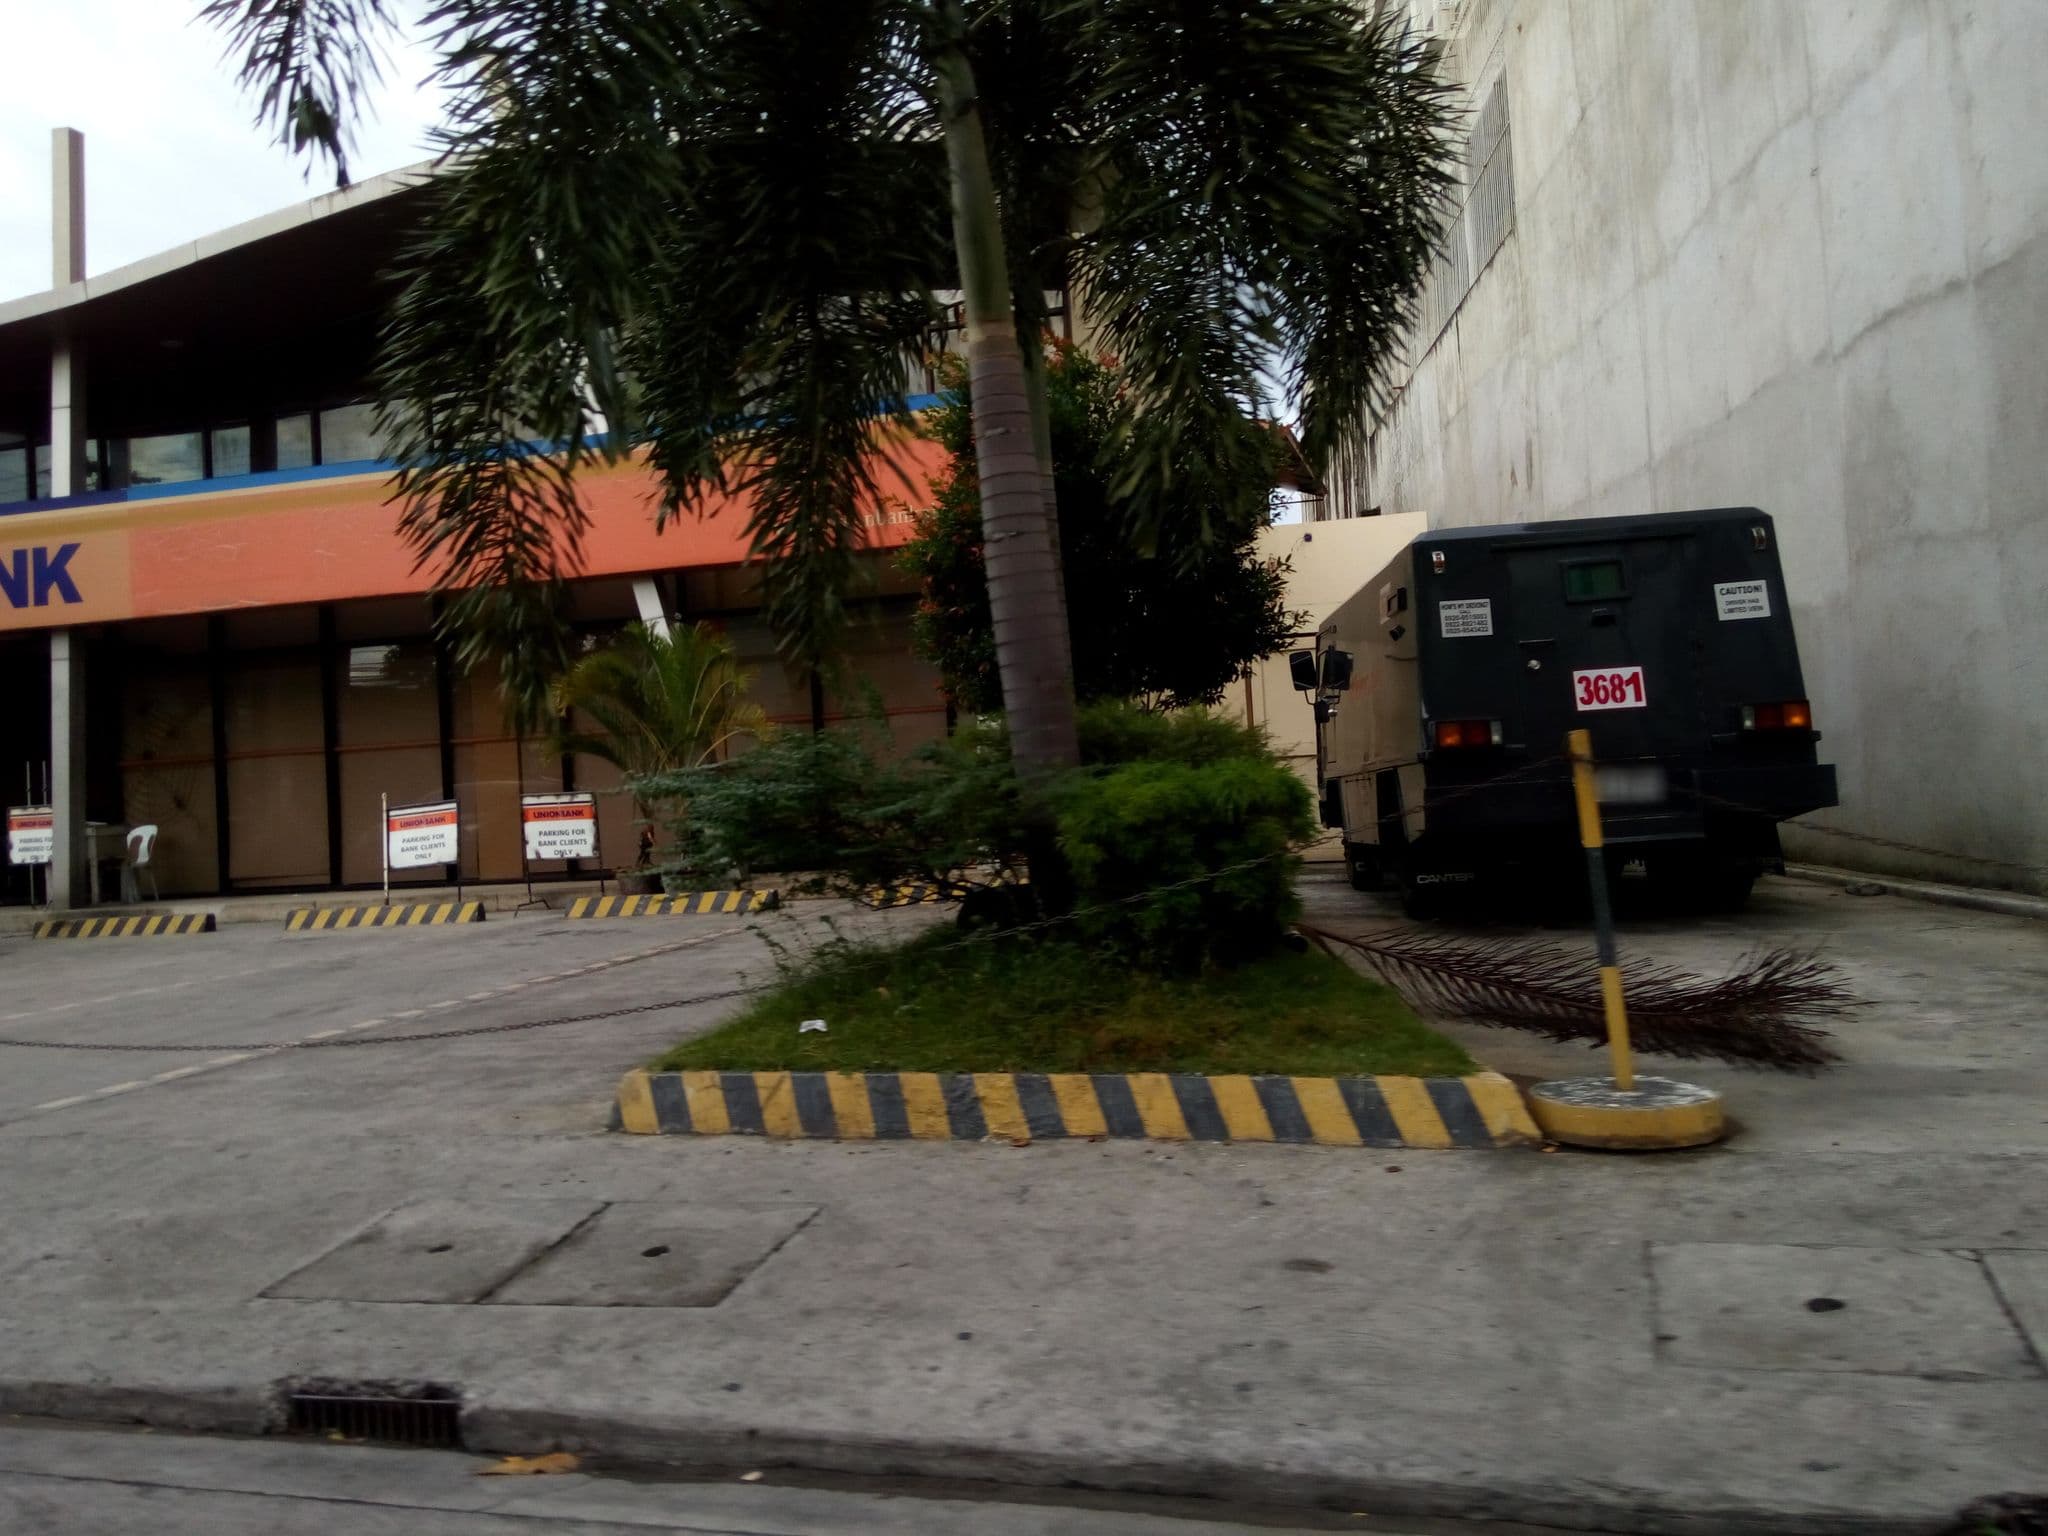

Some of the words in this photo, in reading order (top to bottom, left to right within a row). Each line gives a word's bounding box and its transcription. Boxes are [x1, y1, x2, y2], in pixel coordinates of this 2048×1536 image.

[1720, 584, 1763, 596] CAUTION!
[1577, 671, 1643, 705] 3681
[402, 835, 431, 844] PARKING
[559, 838, 588, 846] CLIENTS
[401, 845, 419, 853] BANK
[420, 842, 446, 851] CLIENTS
